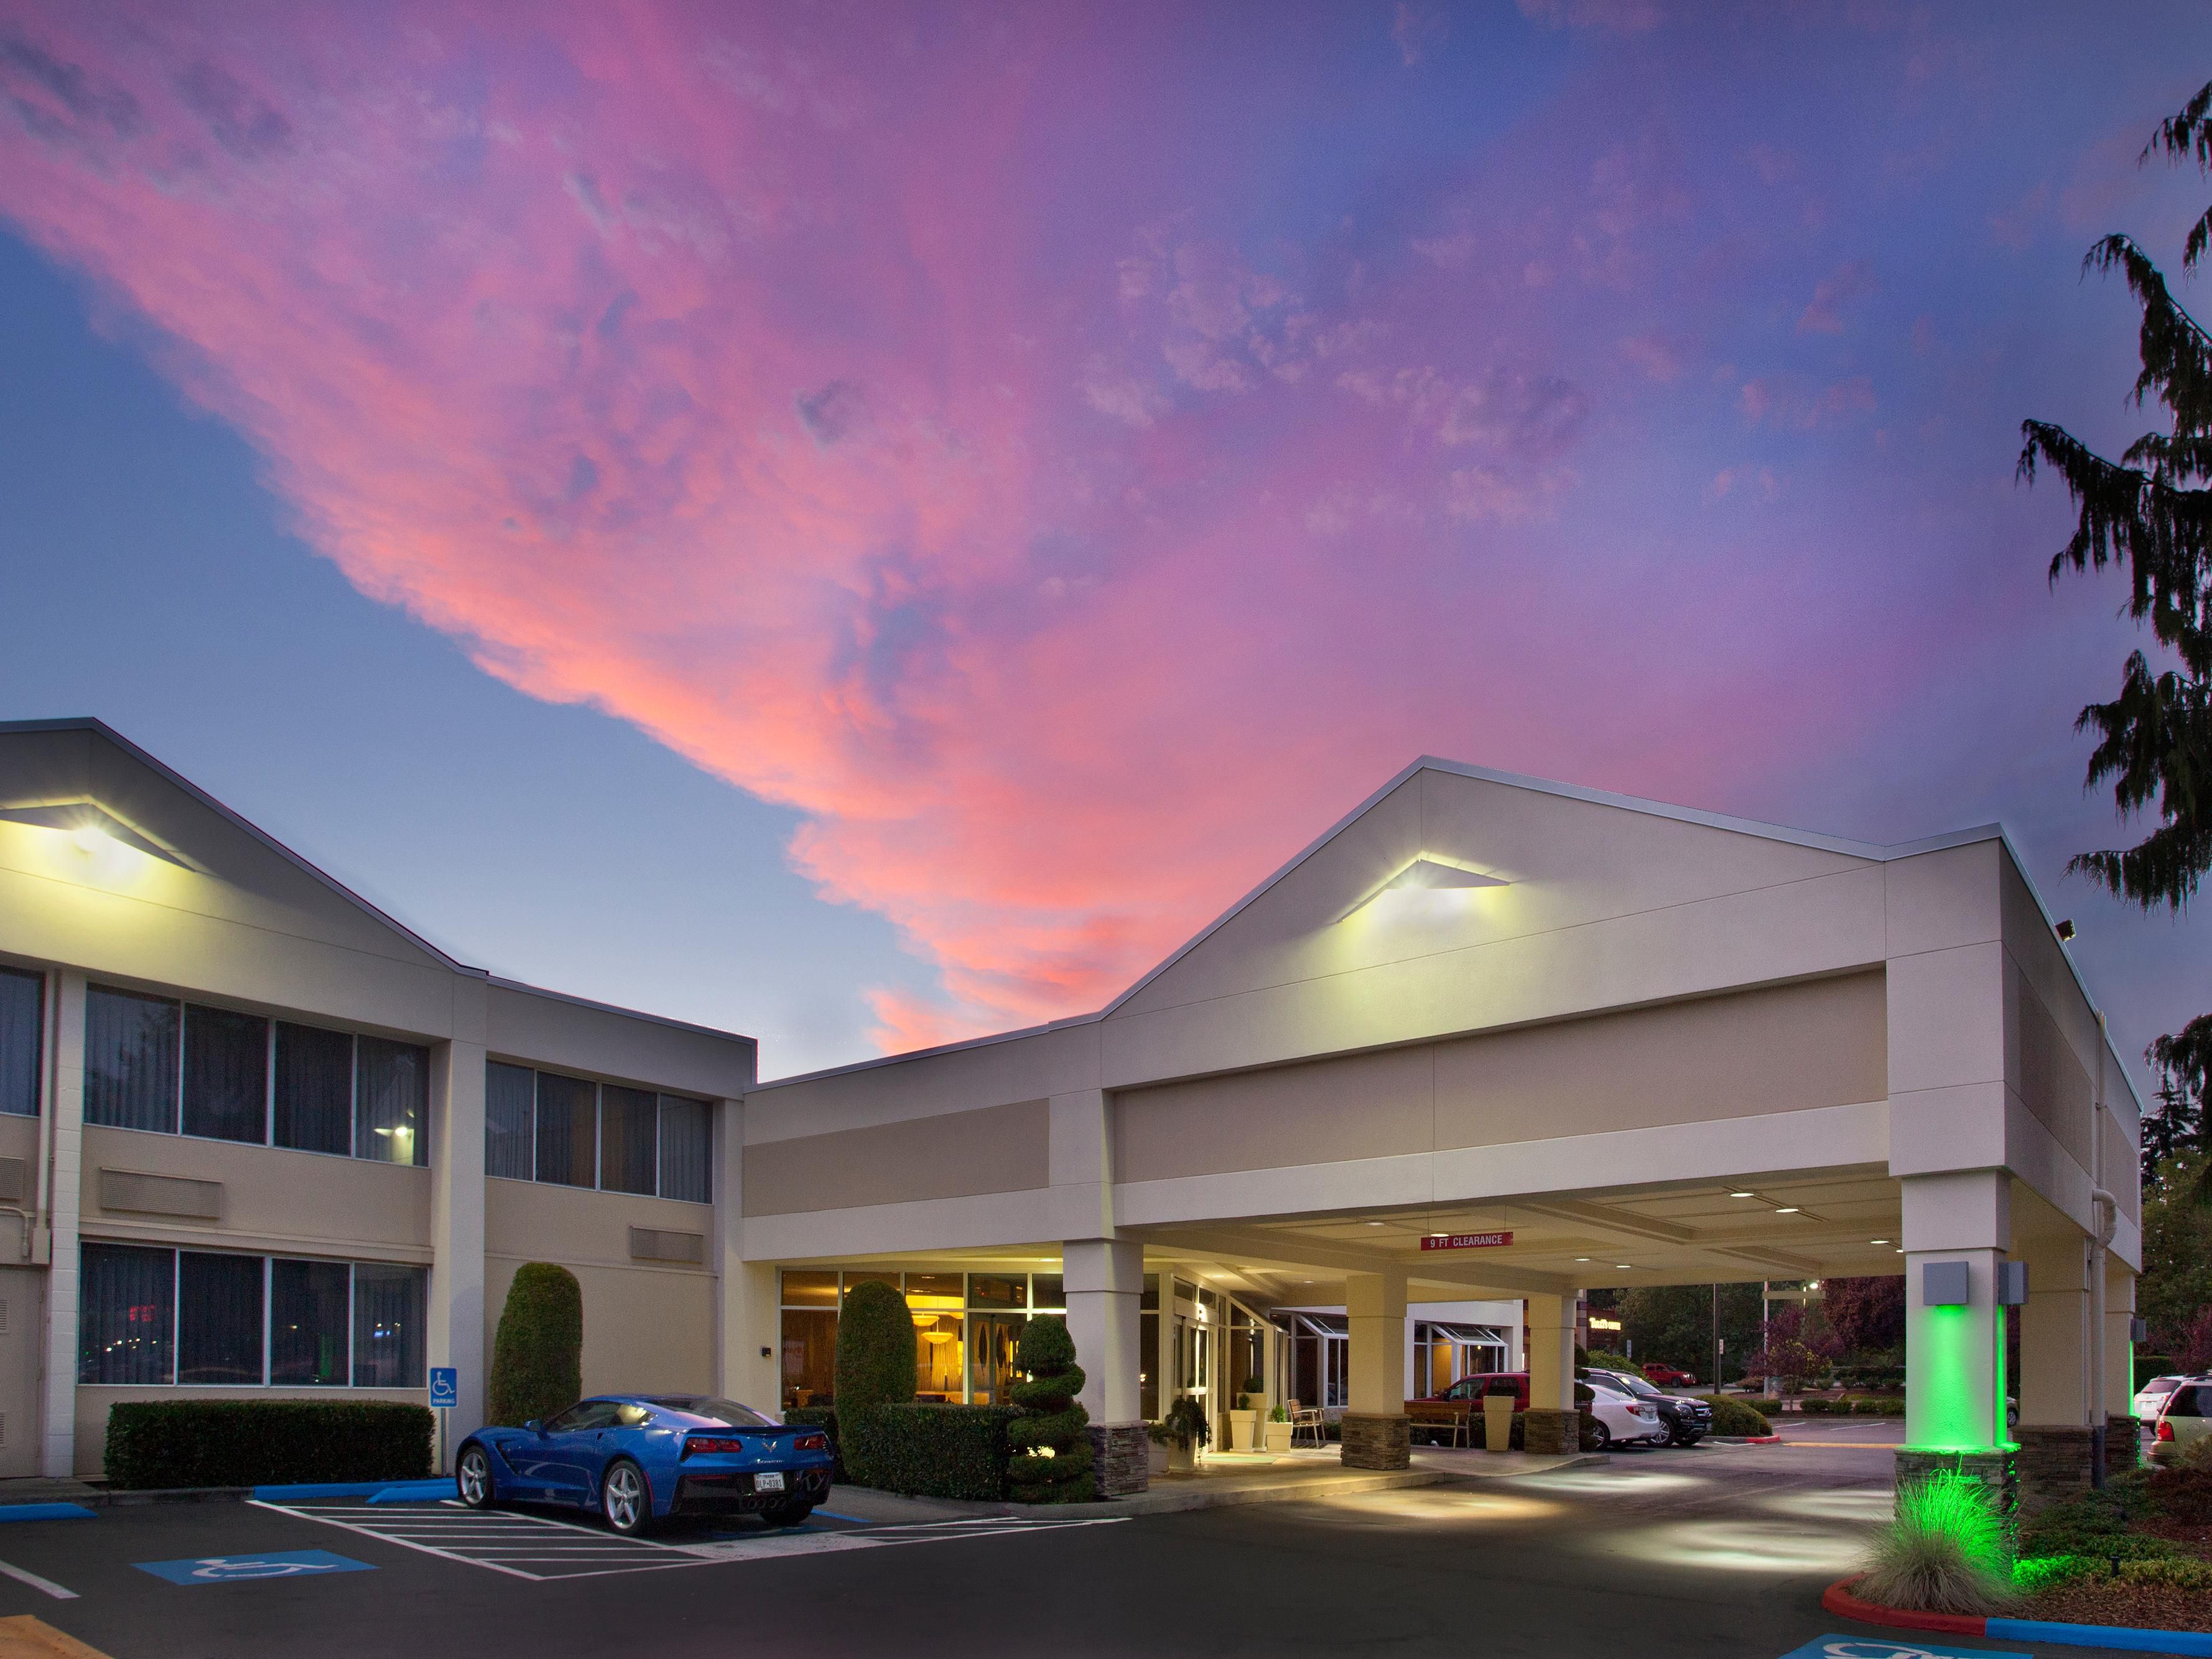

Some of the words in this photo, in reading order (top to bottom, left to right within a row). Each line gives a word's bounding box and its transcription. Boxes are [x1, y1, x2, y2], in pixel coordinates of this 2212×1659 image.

[1430, 1238, 1436, 1248] 9
[1439, 1238, 1449, 1247] FT
[1452, 1235, 1503, 1247] CLEARANCE
